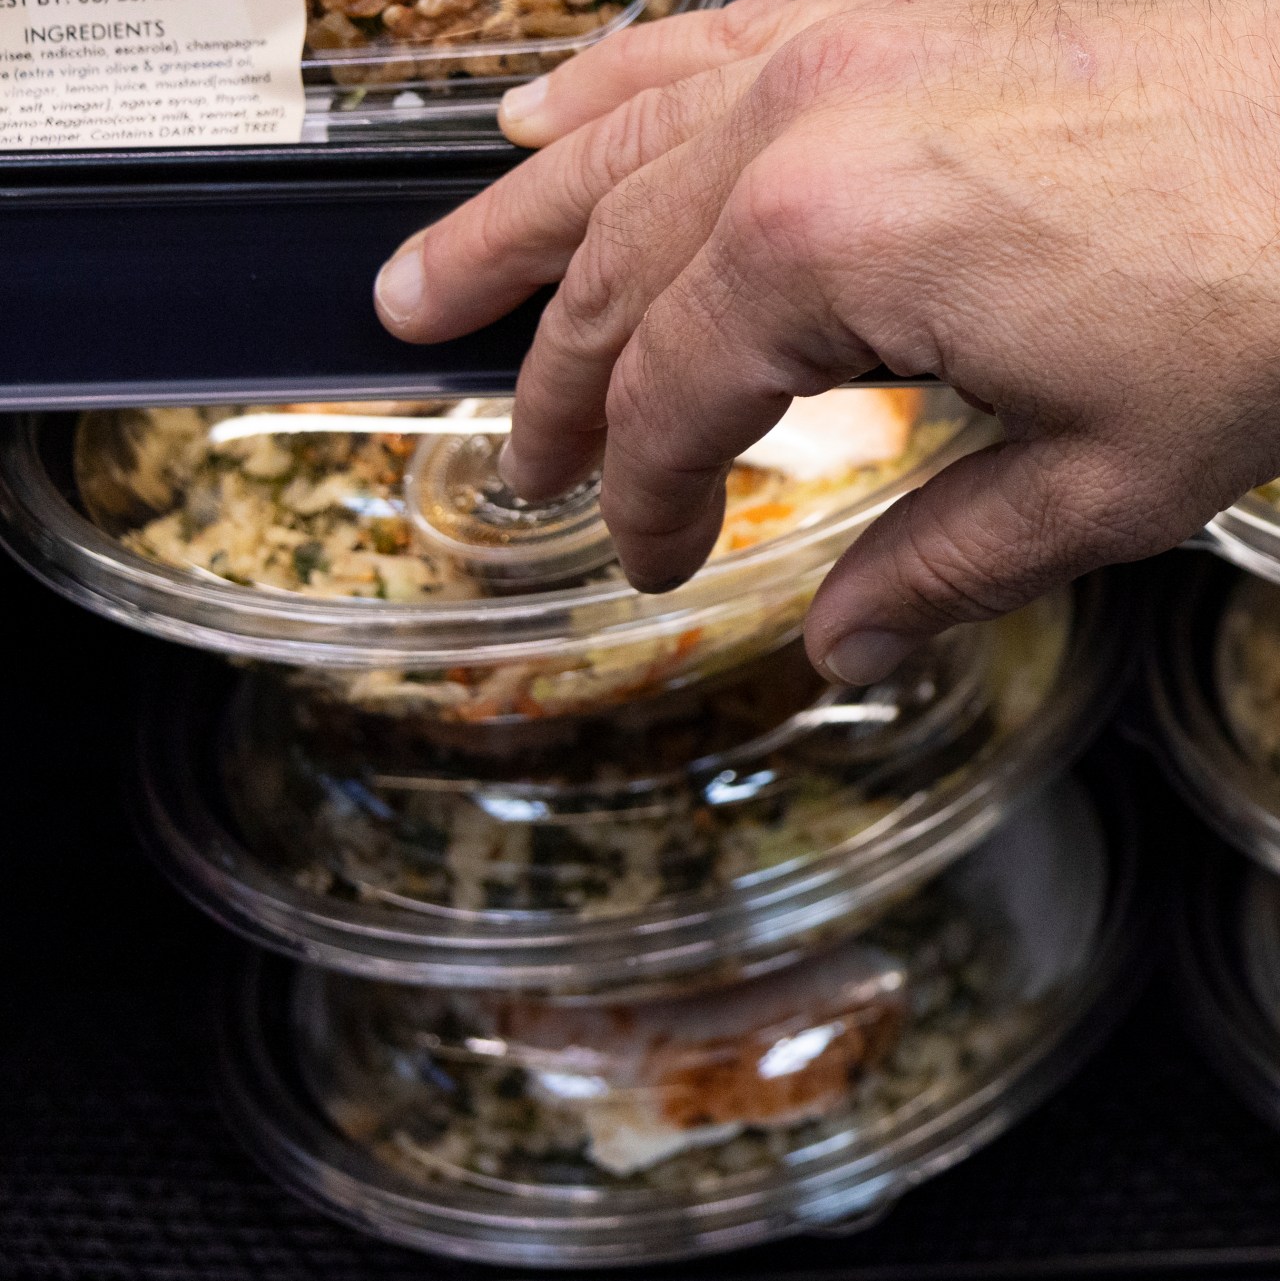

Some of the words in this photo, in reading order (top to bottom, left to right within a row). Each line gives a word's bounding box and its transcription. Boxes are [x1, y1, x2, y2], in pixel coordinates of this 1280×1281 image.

[24, 20, 165, 44] INGREDIENTS
[60, 62, 100, 79] virgin
[105, 60, 139, 75] olive
[143, 59, 153, 72] &
